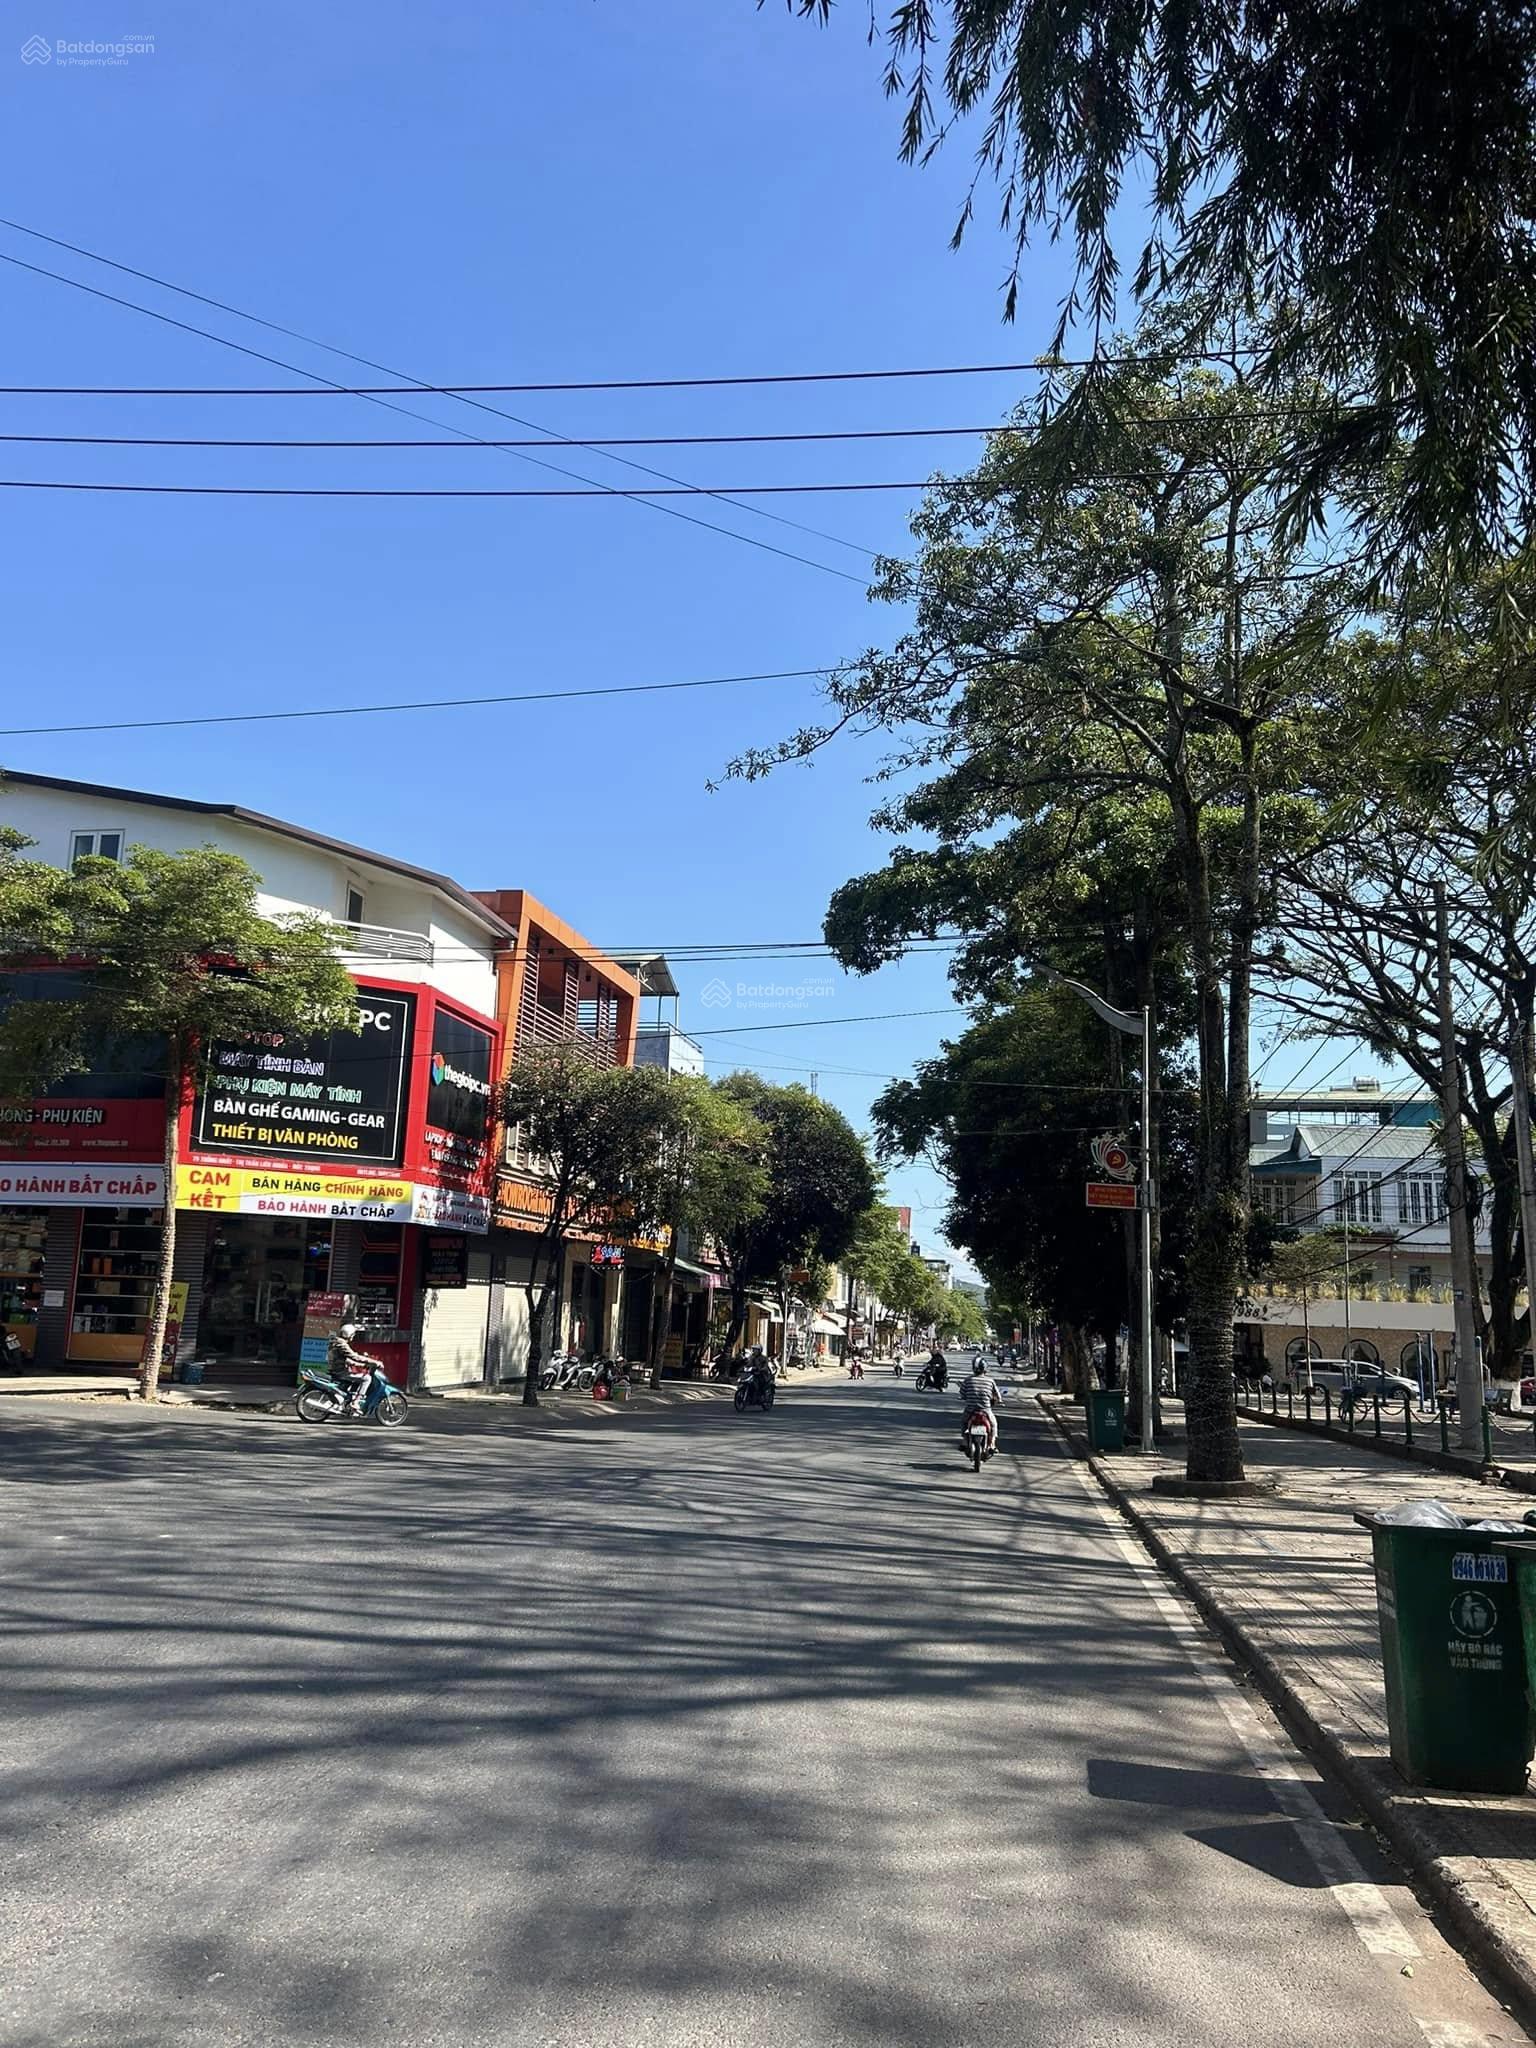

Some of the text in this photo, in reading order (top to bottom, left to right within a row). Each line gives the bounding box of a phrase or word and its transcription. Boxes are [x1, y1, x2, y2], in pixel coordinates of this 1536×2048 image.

[358, 1008, 391, 1031] PC
[256, 1053, 291, 1072] TÍNH
[292, 1058, 325, 1076] BÀN
[216, 1075, 362, 1103] PHỤ KIỆN MÁY TÍNH
[42, 1108, 70, 1127] PHỤ
[72, 1106, 103, 1127] KIỆN
[213, 1098, 246, 1115] BÀN
[248, 1101, 281, 1119] GHẾ
[212, 1121, 359, 1149] THIẾT BỊ VĂN PHÒNG
[16, 1176, 65, 1193] HÀNH
[69, 1174, 103, 1193] BẤT
[107, 1175, 157, 1195] CHẤP
[190, 1170, 231, 1186] CAM
[252, 1176, 280, 1190] BÁN
[284, 1178, 321, 1192] HÀNG
[369, 1184, 403, 1198] HÃNG
[190, 1188, 226, 1208] KẾT
[257, 1197, 395, 1218] BẢO HÀNH BẤT CHẤP
